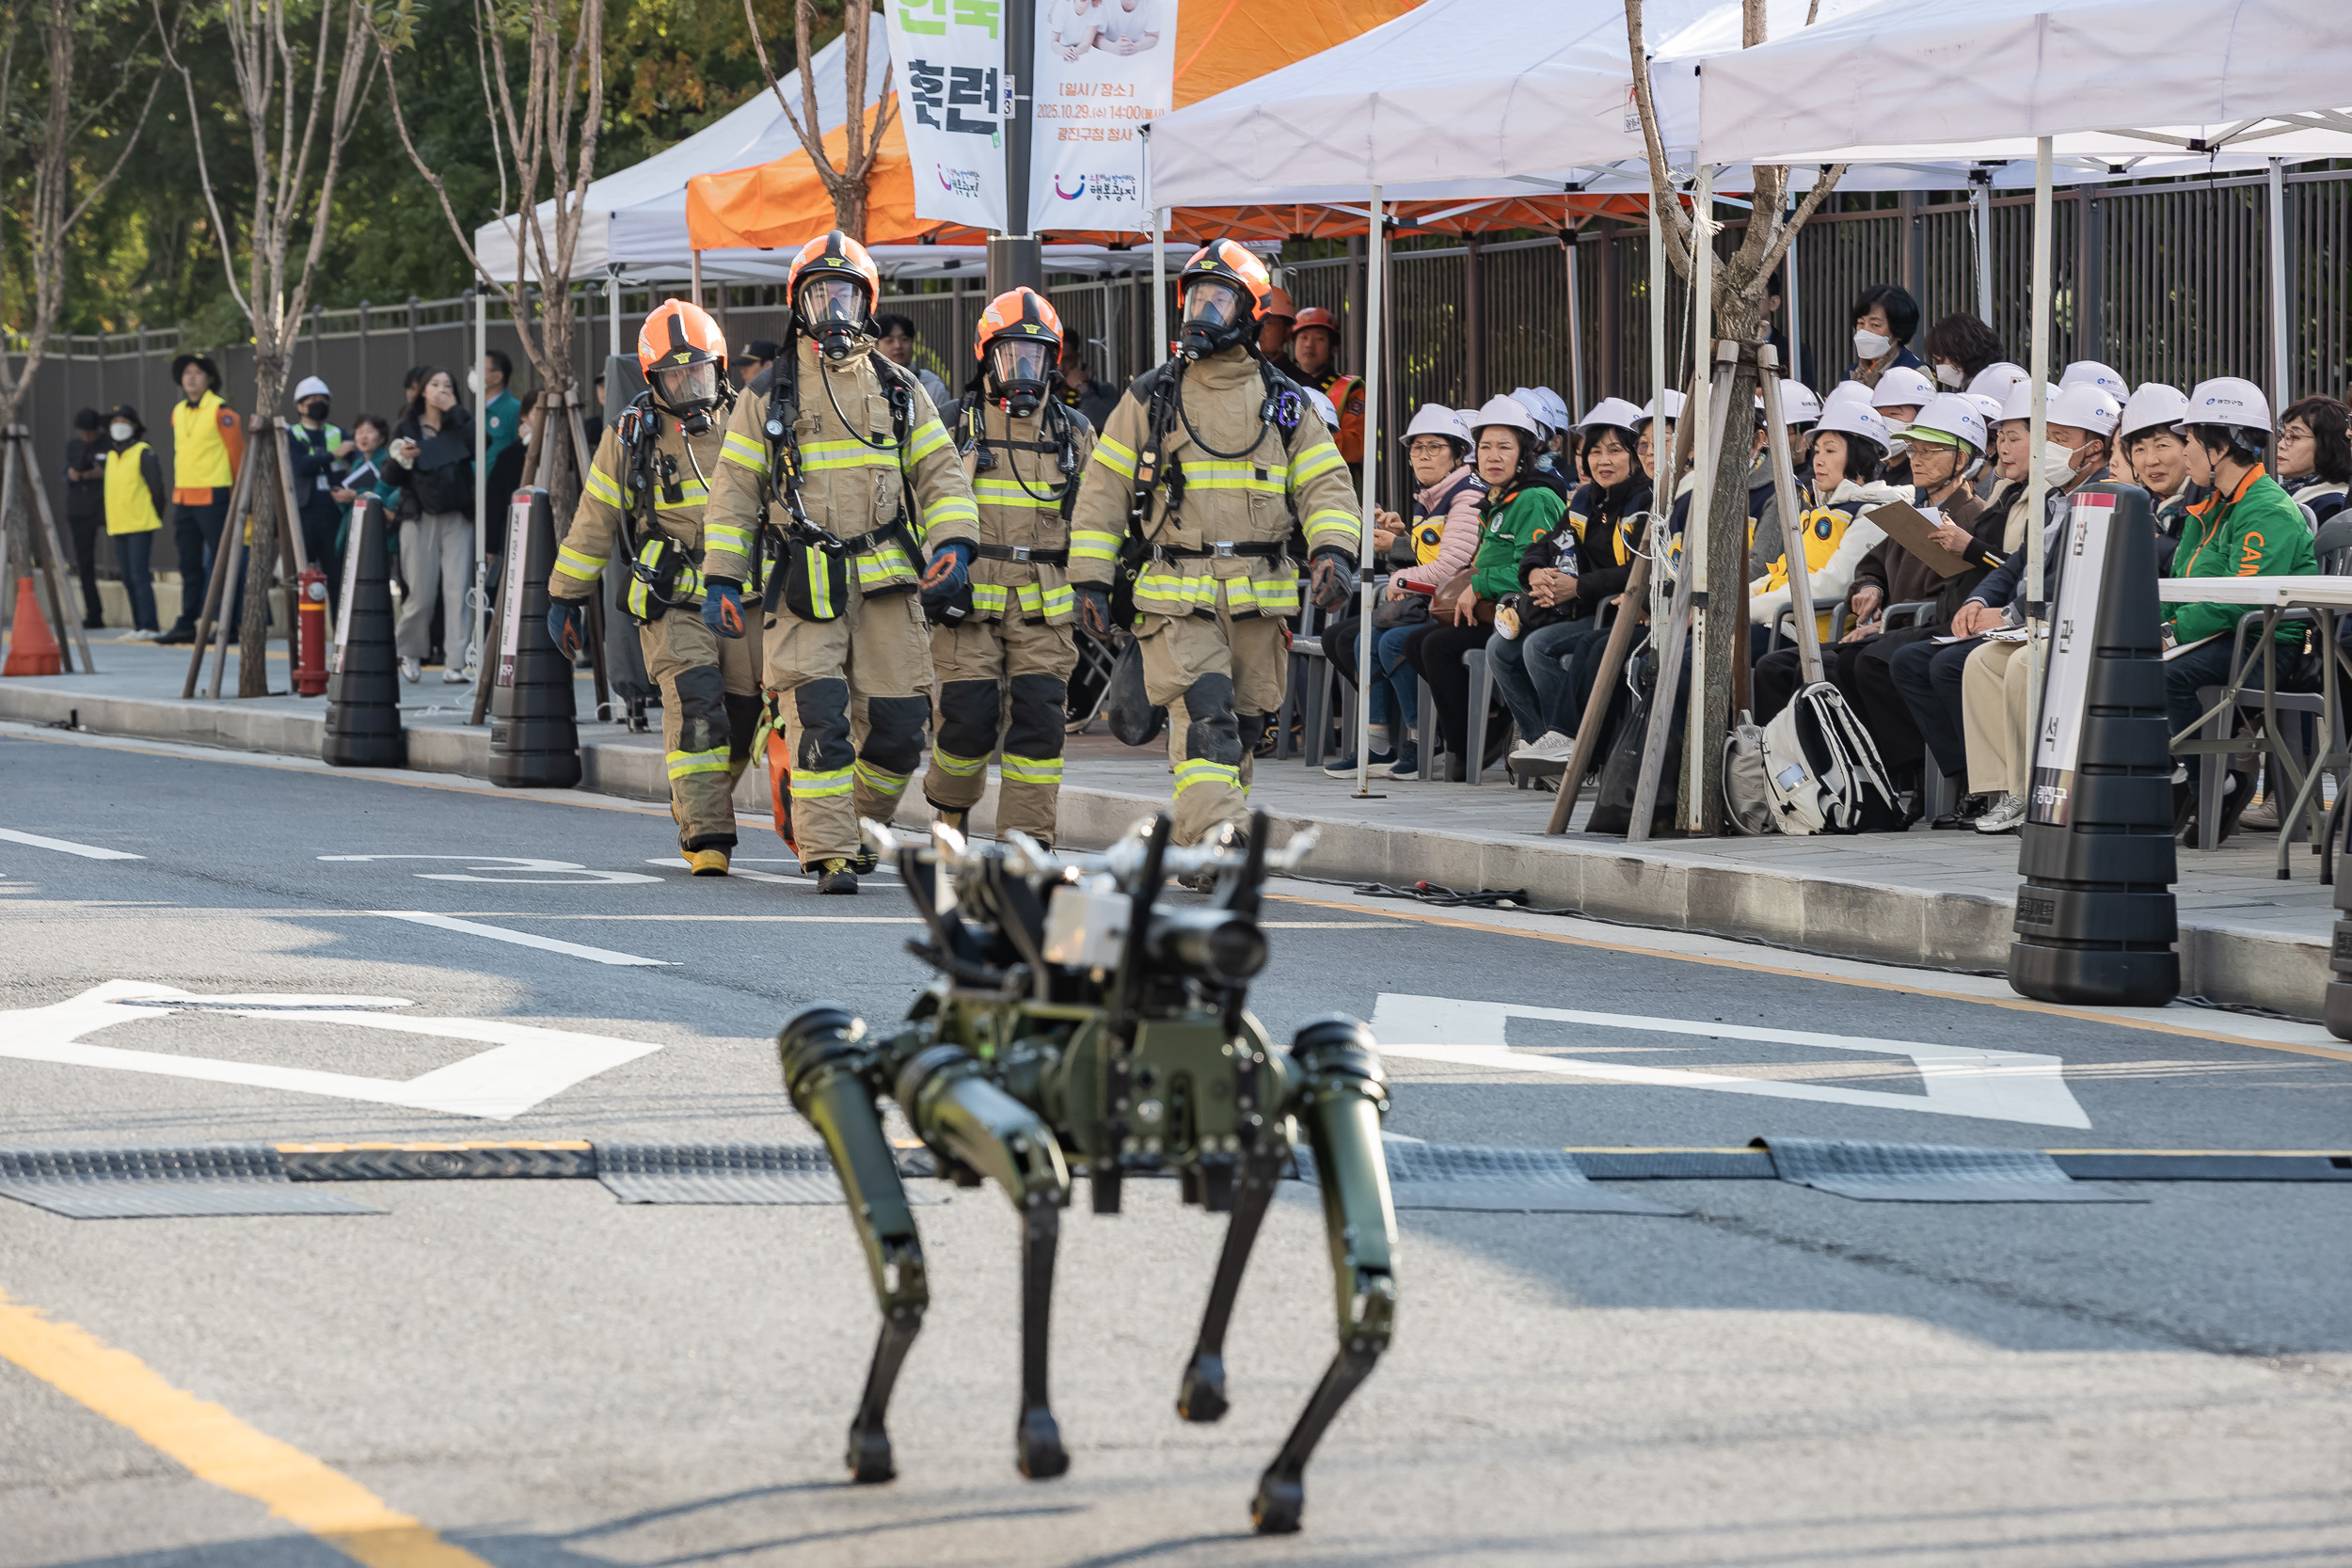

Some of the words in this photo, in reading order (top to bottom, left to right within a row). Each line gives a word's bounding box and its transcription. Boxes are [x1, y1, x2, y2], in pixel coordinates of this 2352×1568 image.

[908, 58, 998, 135] 훈련
[1037, 103, 1106, 119] 2025.10.29.(수)
[1057, 127, 1104, 141] 광진구청
[1107, 128, 1134, 142] 청사
[1089, 182, 1136, 202] 행복광진
